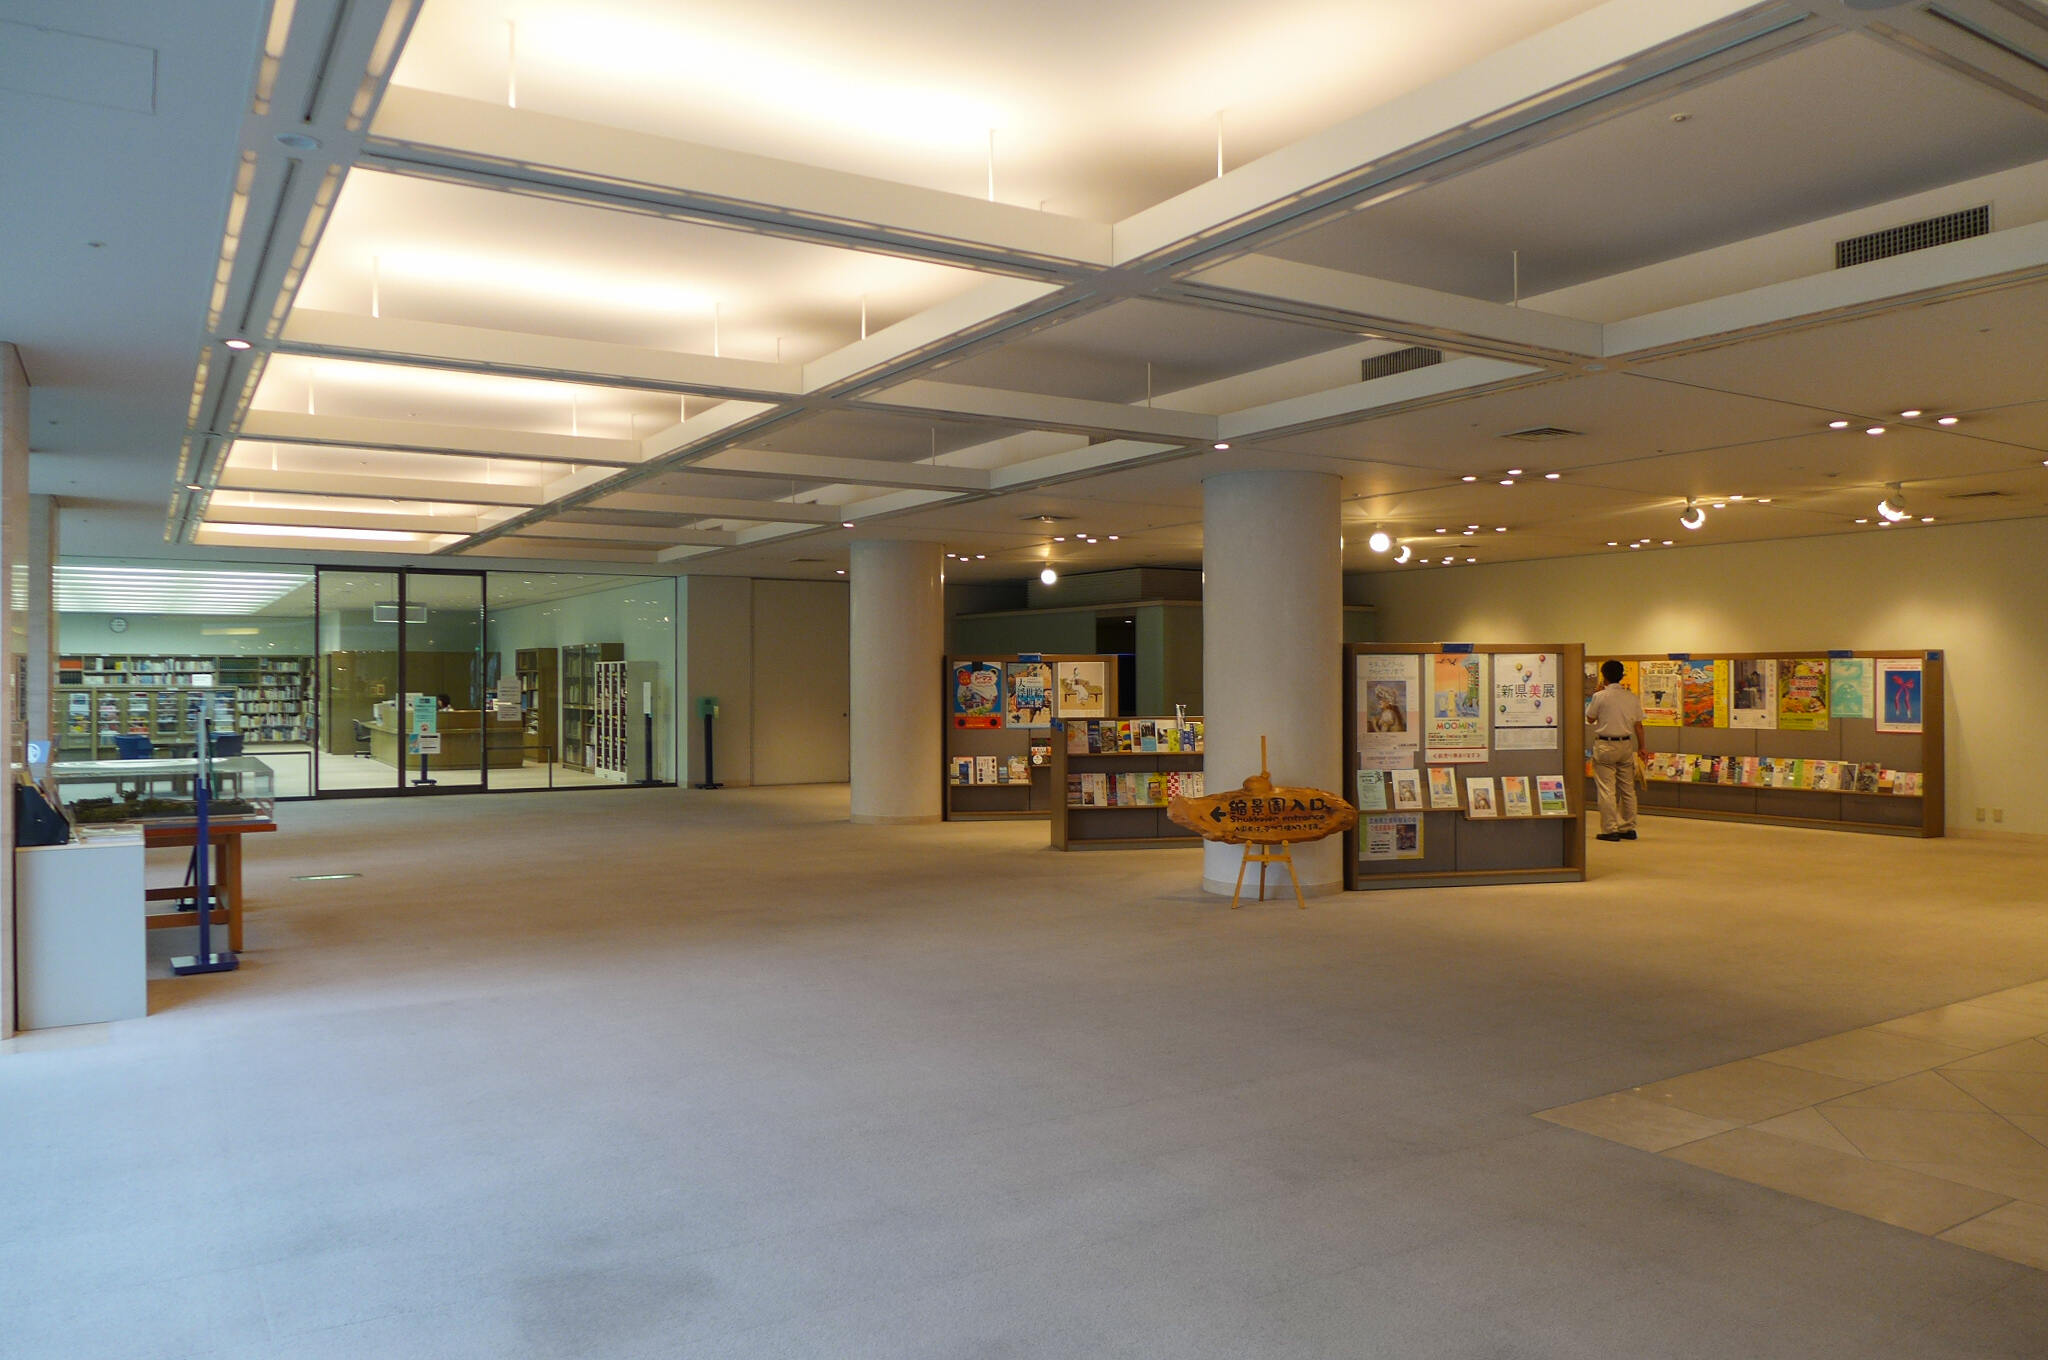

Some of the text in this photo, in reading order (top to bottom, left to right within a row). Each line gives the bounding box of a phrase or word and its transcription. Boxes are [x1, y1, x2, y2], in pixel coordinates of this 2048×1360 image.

[1502, 683, 1556, 699] 新県美展
[1228, 797, 1332, 816] 縮景園入口
[1282, 813, 1326, 823] entrance
